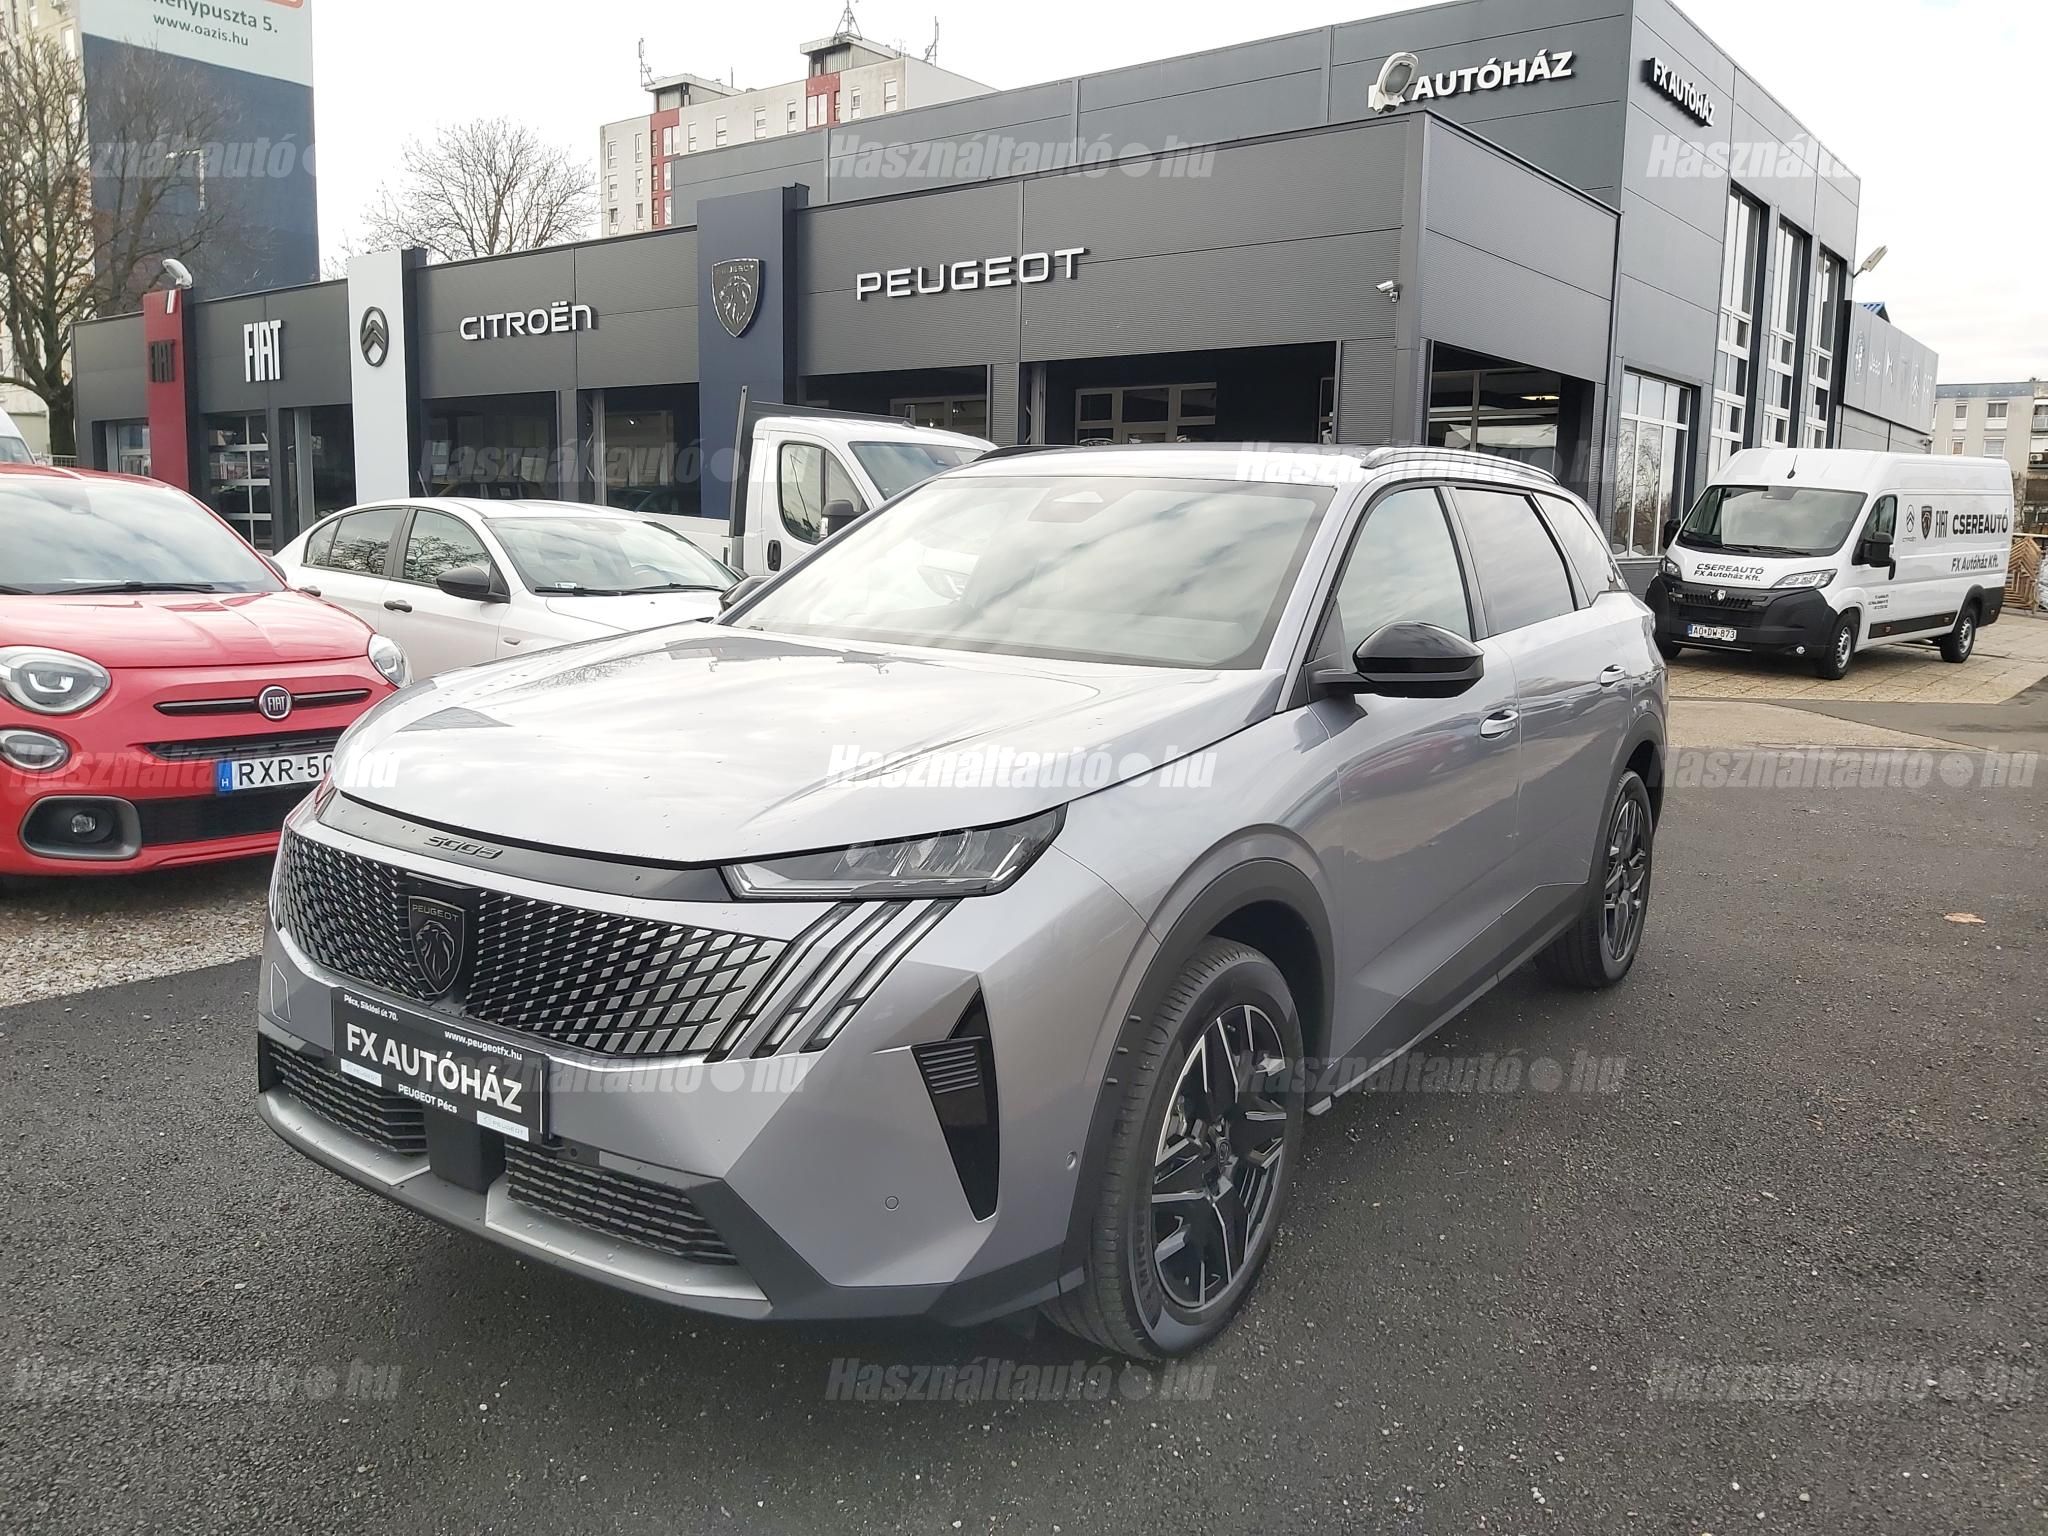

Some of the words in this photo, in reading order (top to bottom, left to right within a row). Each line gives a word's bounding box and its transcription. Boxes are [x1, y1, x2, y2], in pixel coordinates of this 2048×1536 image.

[153, 14, 249, 46] www.oazis.hu
[263, 16, 278, 33] 5.
[1411, 48, 1573, 101] AUTÓHÁZ
[1653, 57, 1668, 90] FX
[1668, 71, 1715, 127] AUTÓHÁZ
[856, 247, 1085, 301] PEUGEOT
[151, 340, 174, 382] FIAT
[243, 319, 282, 382] FIAT
[1935, 510, 1949, 538] FIAT
[1952, 508, 2009, 535] CSEREAUTÓ
[1694, 569, 1706, 577] FX
[1696, 563, 1765, 575] CSEREAUTÓ
[1951, 557, 1961, 573] FX
[267, 695, 286, 711] FIAT
[412, 904, 459, 922] PEUGEOT
[444, 1030, 523, 1061] www.peugeotfx.hu
[346, 1022, 378, 1063] FX
[382, 1038, 522, 1114] AUTÓHÁZ
[398, 1084, 437, 1106] PEUGEOT
[437, 1098, 458, 1114] Pécs
